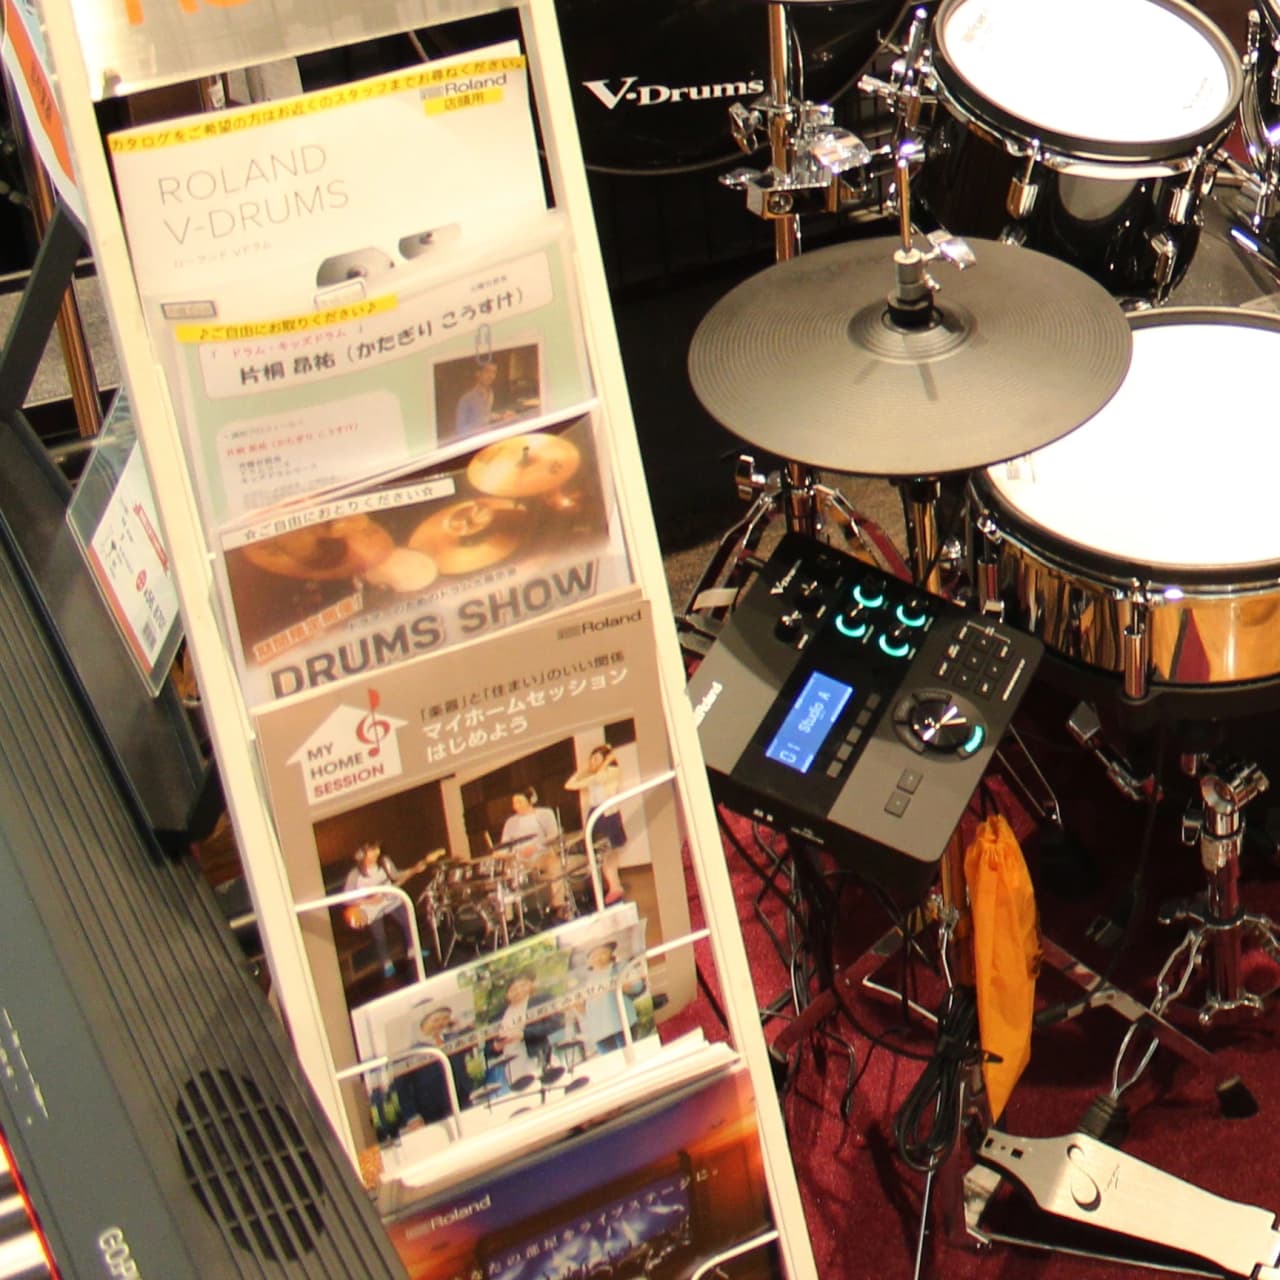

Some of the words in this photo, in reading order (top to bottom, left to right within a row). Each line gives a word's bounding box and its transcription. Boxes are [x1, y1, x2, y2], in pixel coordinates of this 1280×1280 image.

[444, 73, 508, 96] Roland
[444, 92, 485, 111] 店頭用
[582, 76, 764, 110] V-Drums
[112, 58, 522, 152] カタログをご希望の方はお近くのスタッフまでお尋ねください。
[158, 144, 327, 206] ROLAND
[164, 180, 350, 246] V-DRUMS
[240, 361, 285, 385] 片桐
[270, 617, 444, 701] DRUMS
[459, 560, 599, 634] SHOW
[581, 610, 642, 636] Roland
[423, 668, 627, 741] マイホームセッション
[798, 703, 824, 734] Studio
[818, 690, 832, 701] A
[307, 742, 334, 761] MY
[427, 718, 528, 763] はじめよう
[310, 752, 363, 779] HOME
[313, 765, 385, 798] SESSION
[430, 1194, 492, 1231] Roland
